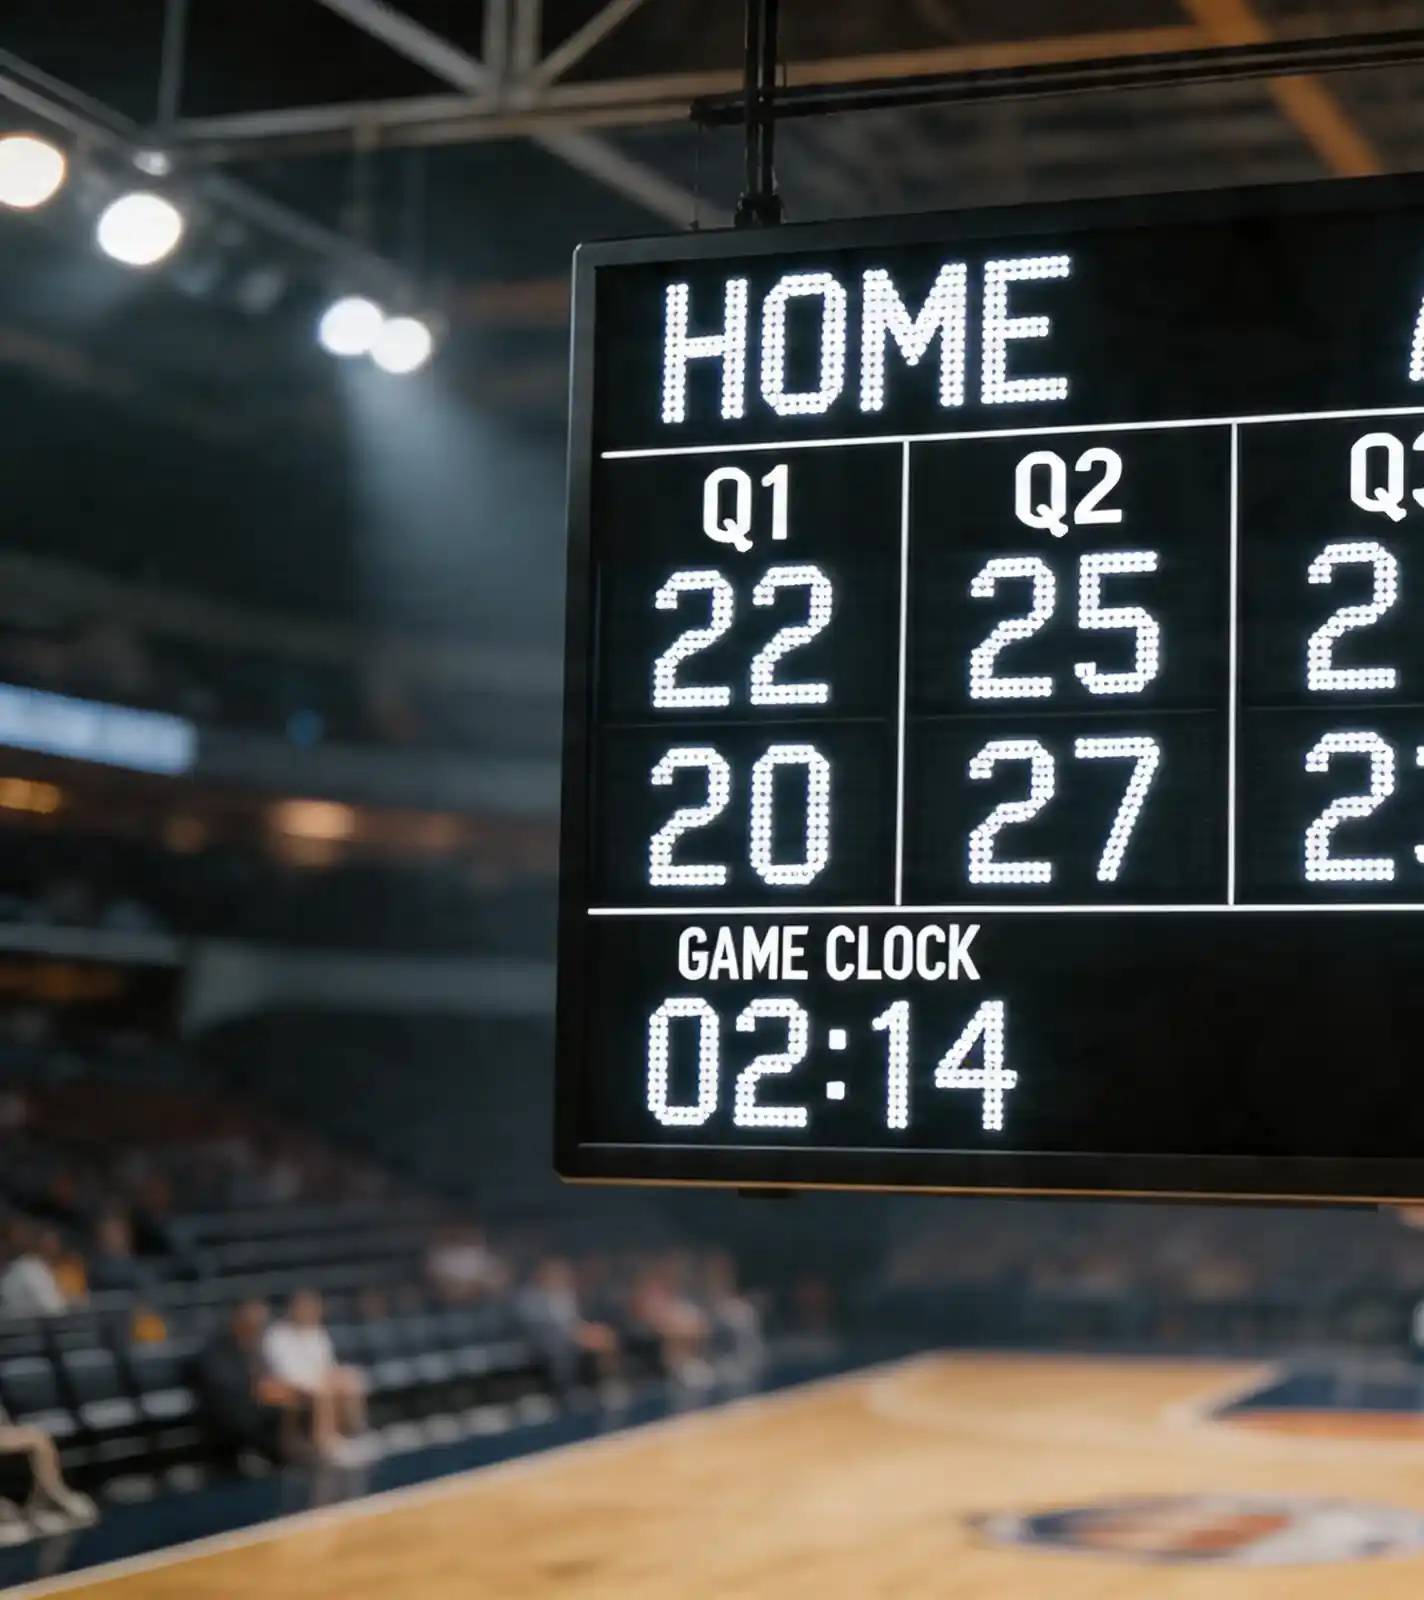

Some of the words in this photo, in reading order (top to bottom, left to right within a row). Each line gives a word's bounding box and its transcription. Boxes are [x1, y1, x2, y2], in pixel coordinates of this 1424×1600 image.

[662, 256, 1071, 424] HOME
[704, 465, 788, 552] Q1
[1016, 449, 1123, 537] Q2
[654, 566, 832, 708] 22
[971, 552, 1161, 699] 25
[650, 746, 830, 886] 20
[969, 738, 1161, 884] 27
[679, 926, 809, 980] GAME
[826, 924, 981, 981] CLOCK
[647, 998, 1018, 1130] 02:14
